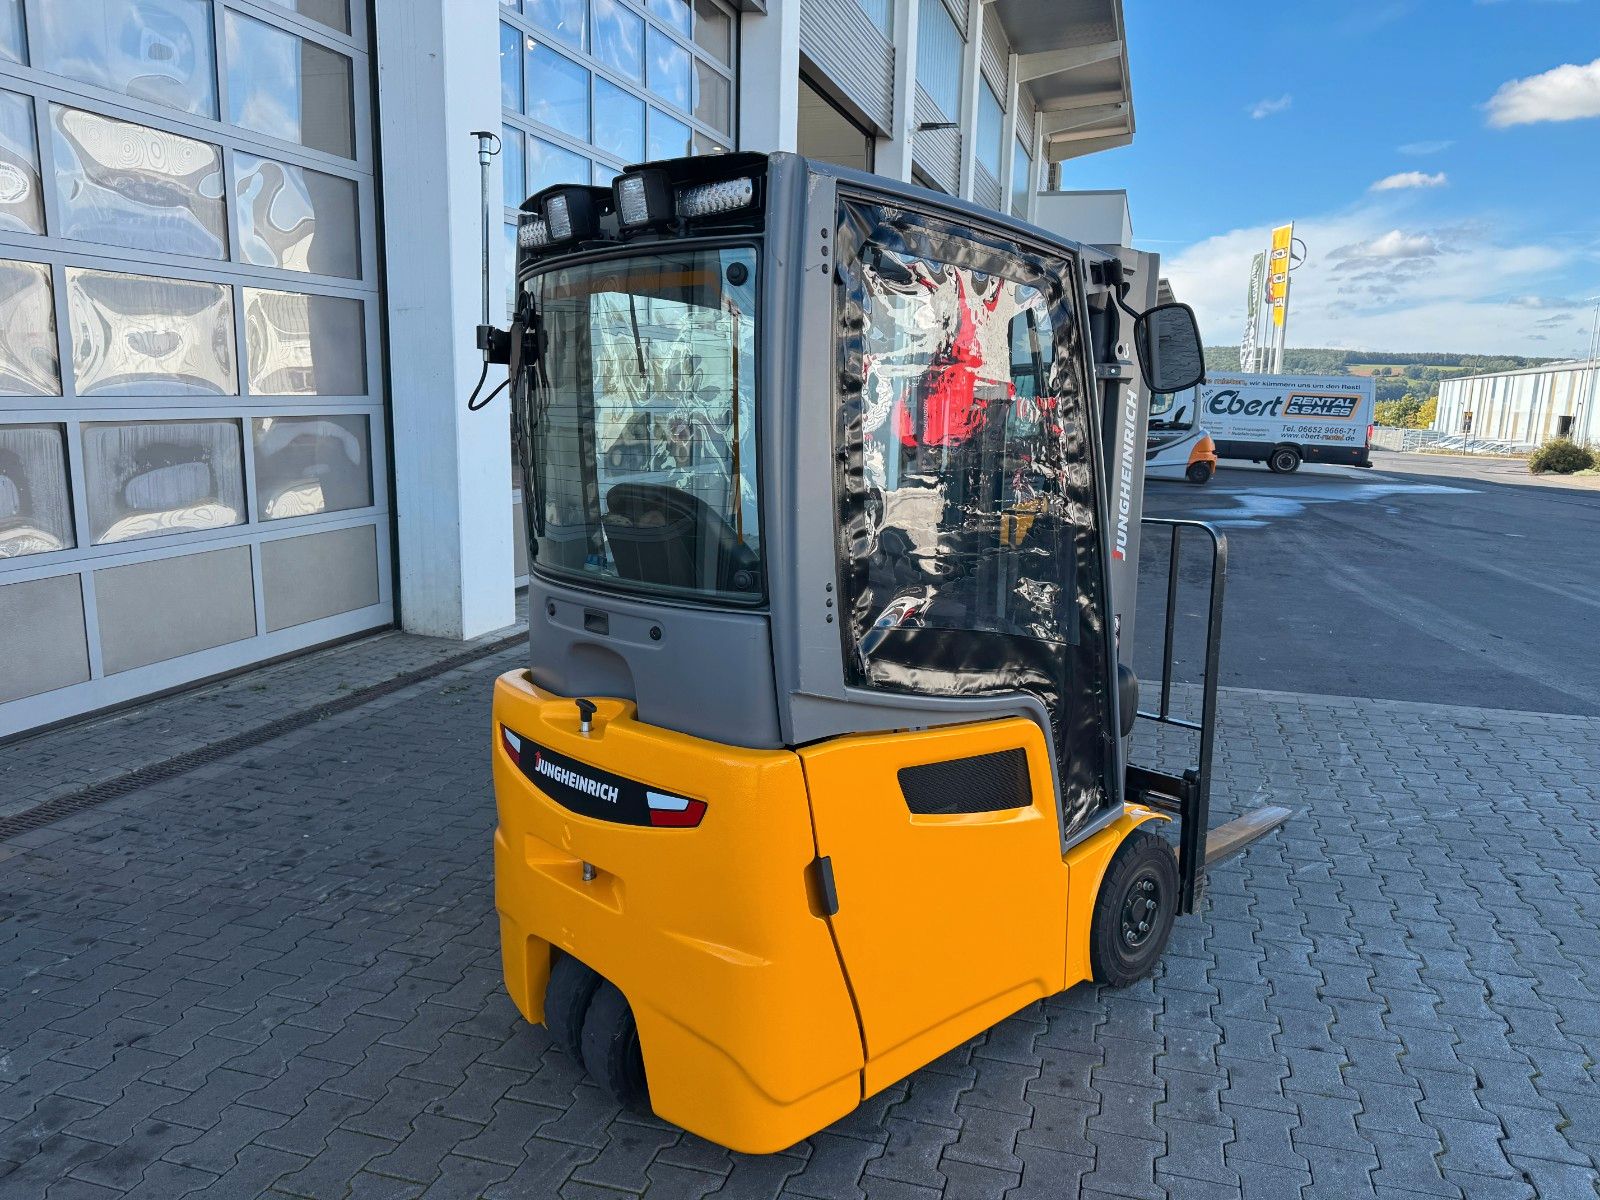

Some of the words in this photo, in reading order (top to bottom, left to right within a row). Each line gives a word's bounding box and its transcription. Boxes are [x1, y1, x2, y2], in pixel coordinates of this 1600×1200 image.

[1209, 389, 1283, 417] Ebert
[1290, 396, 1354, 407] RENTAL
[1297, 425, 1323, 433] 06652
[1324, 427, 1357, 436] 9666-71
[1112, 388, 1137, 561] JUNGHEINRICH
[534, 751, 619, 804] JUNGHEINRICH
